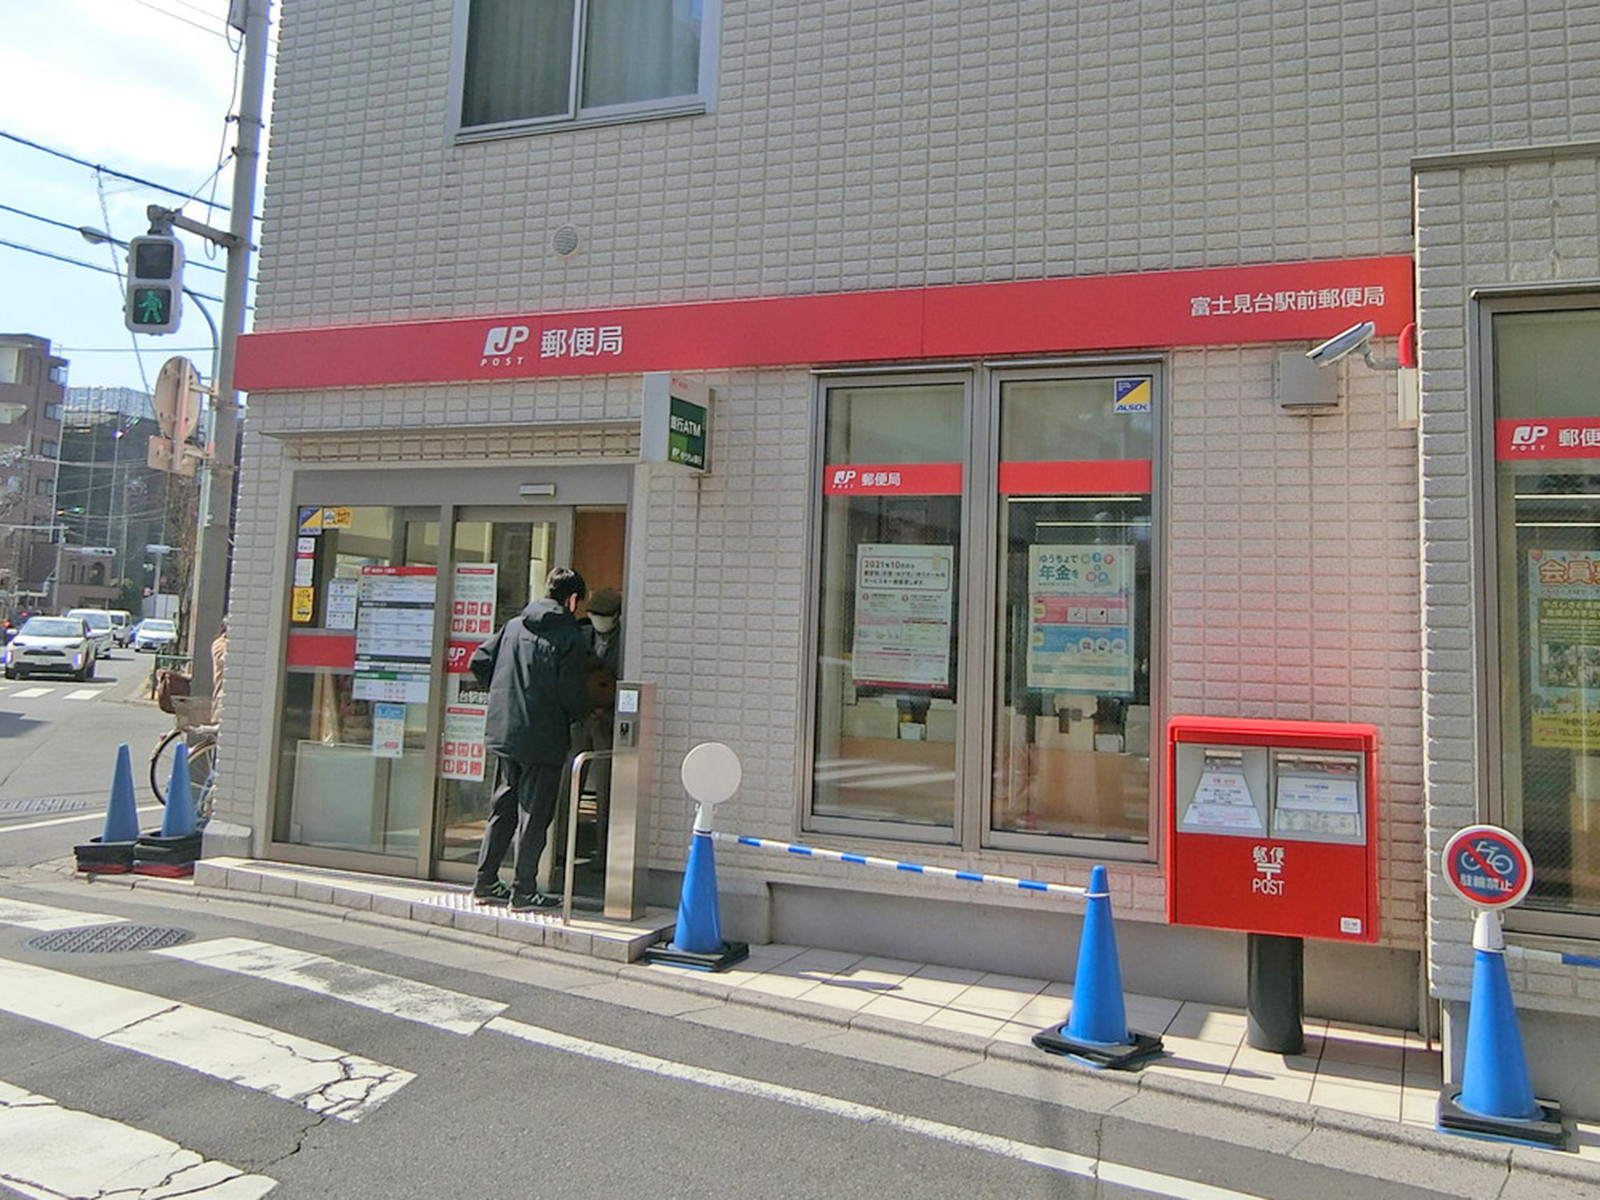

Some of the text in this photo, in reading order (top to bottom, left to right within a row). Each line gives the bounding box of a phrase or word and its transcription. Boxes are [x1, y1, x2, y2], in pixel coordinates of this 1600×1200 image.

[1190, 285, 1385, 317] 富士見台駅前郵便局
[540, 325, 623, 358] 郵便局
[480, 357, 524, 367] POST
[1558, 428, 1600, 447] 郵便
[861, 472, 902, 486] 郵便局
[1039, 554, 1078, 564] ゆうちょで
[1039, 564, 1079, 581] 年金を
[1252, 845, 1285, 866] 郵便
[1252, 878, 1285, 895] POST
[1460, 873, 1513, 893] 駐輪禁止
